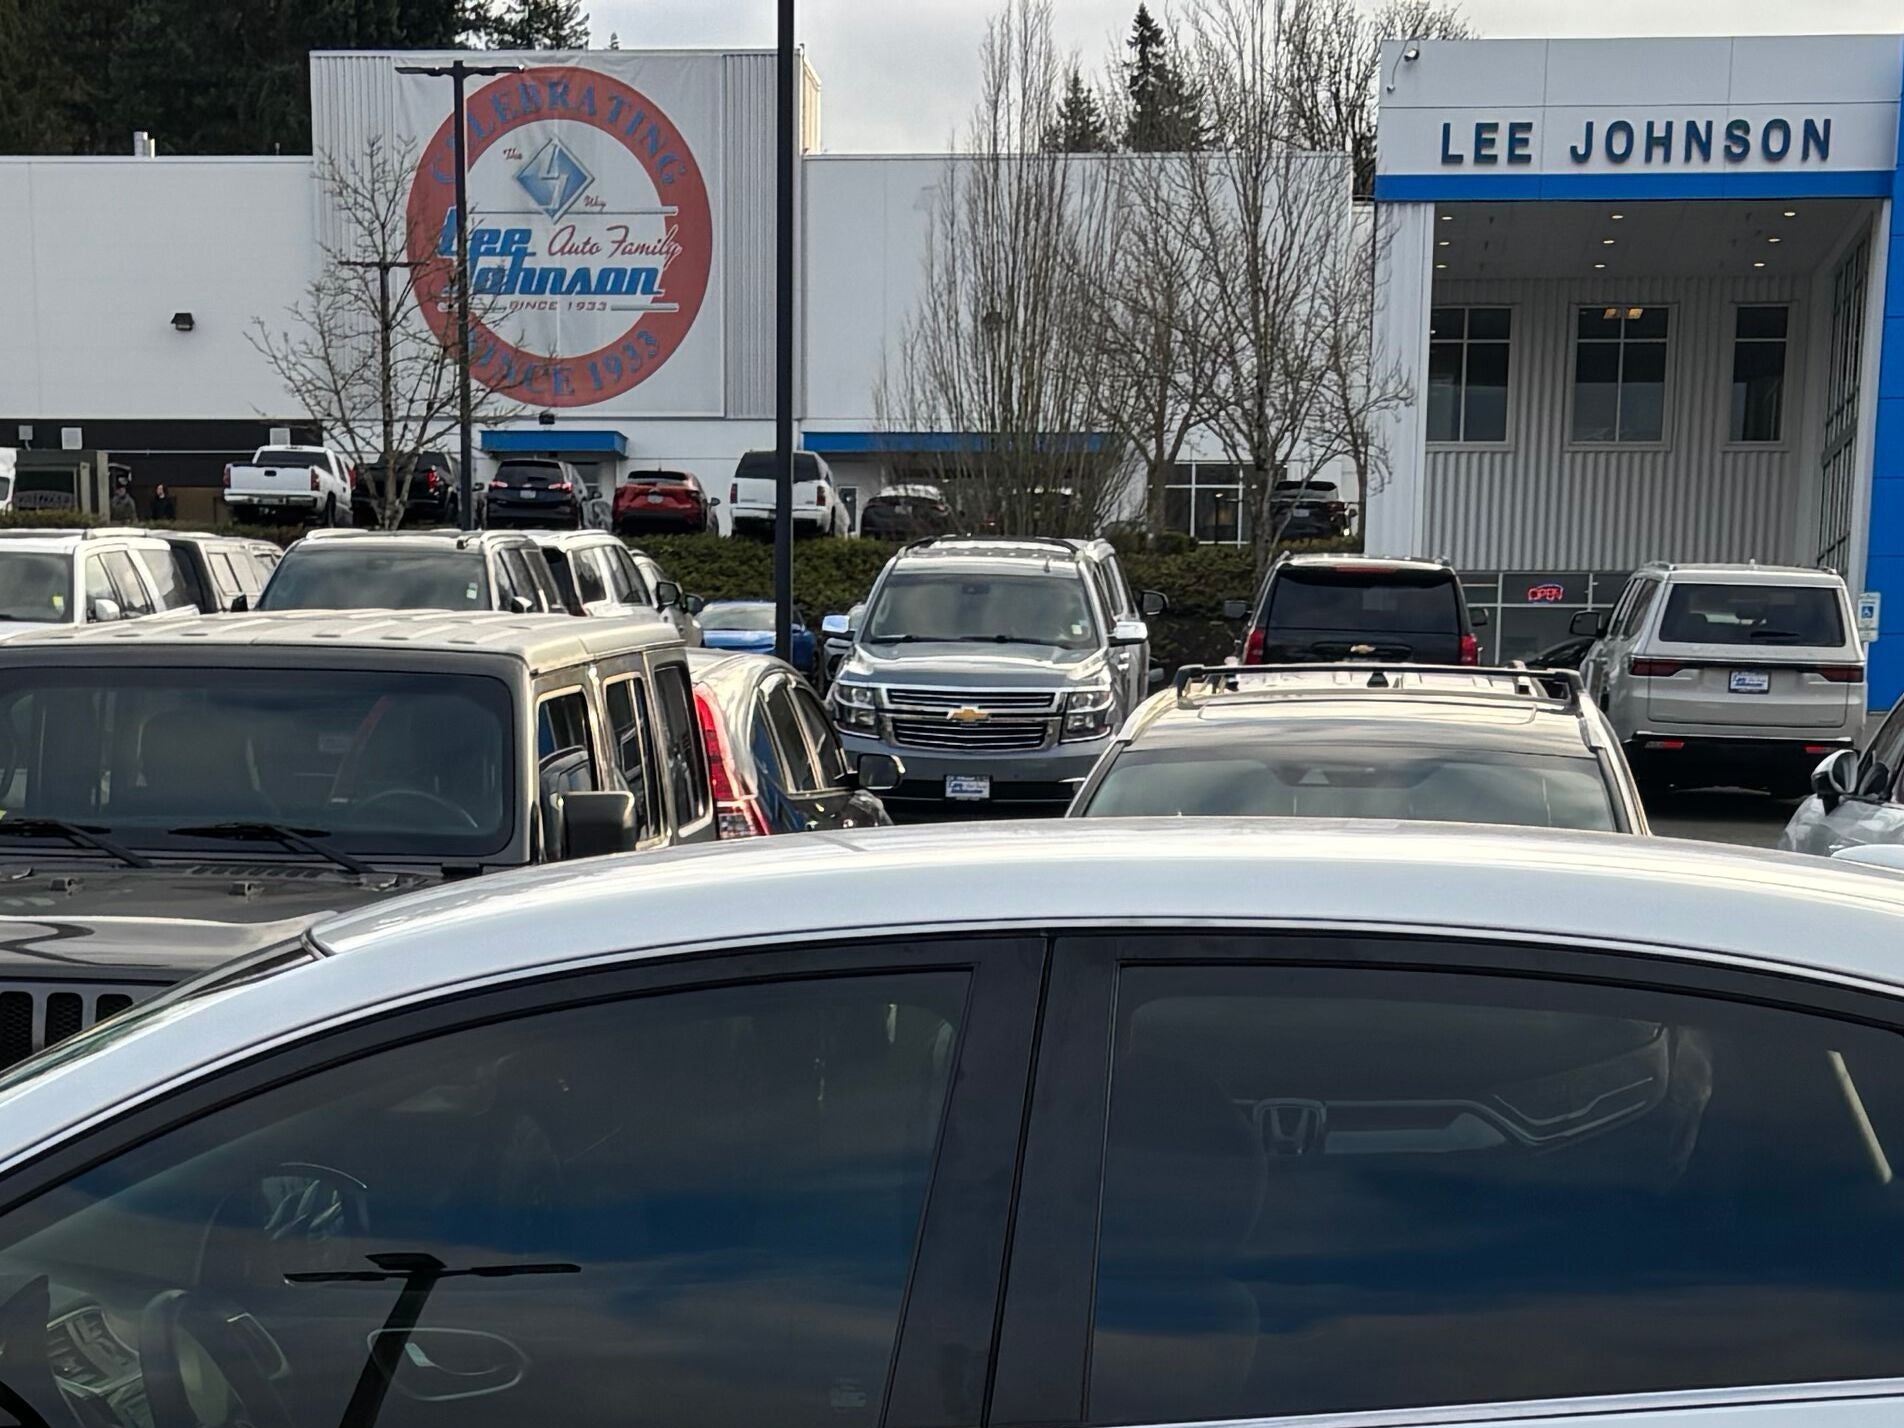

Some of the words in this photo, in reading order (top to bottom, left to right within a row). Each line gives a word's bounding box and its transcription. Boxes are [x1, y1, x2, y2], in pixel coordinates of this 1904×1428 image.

[430, 78, 688, 184] CLEBRATING
[1440, 121, 1534, 165] LEE
[1569, 118, 1833, 165] JOHNSON
[437, 207, 537, 257] Lee
[548, 224, 602, 257] Auto
[605, 224, 684, 270] Family
[508, 300, 559, 312] SINCE
[566, 301, 608, 312] 1933
[586, 328, 659, 393] 1933
